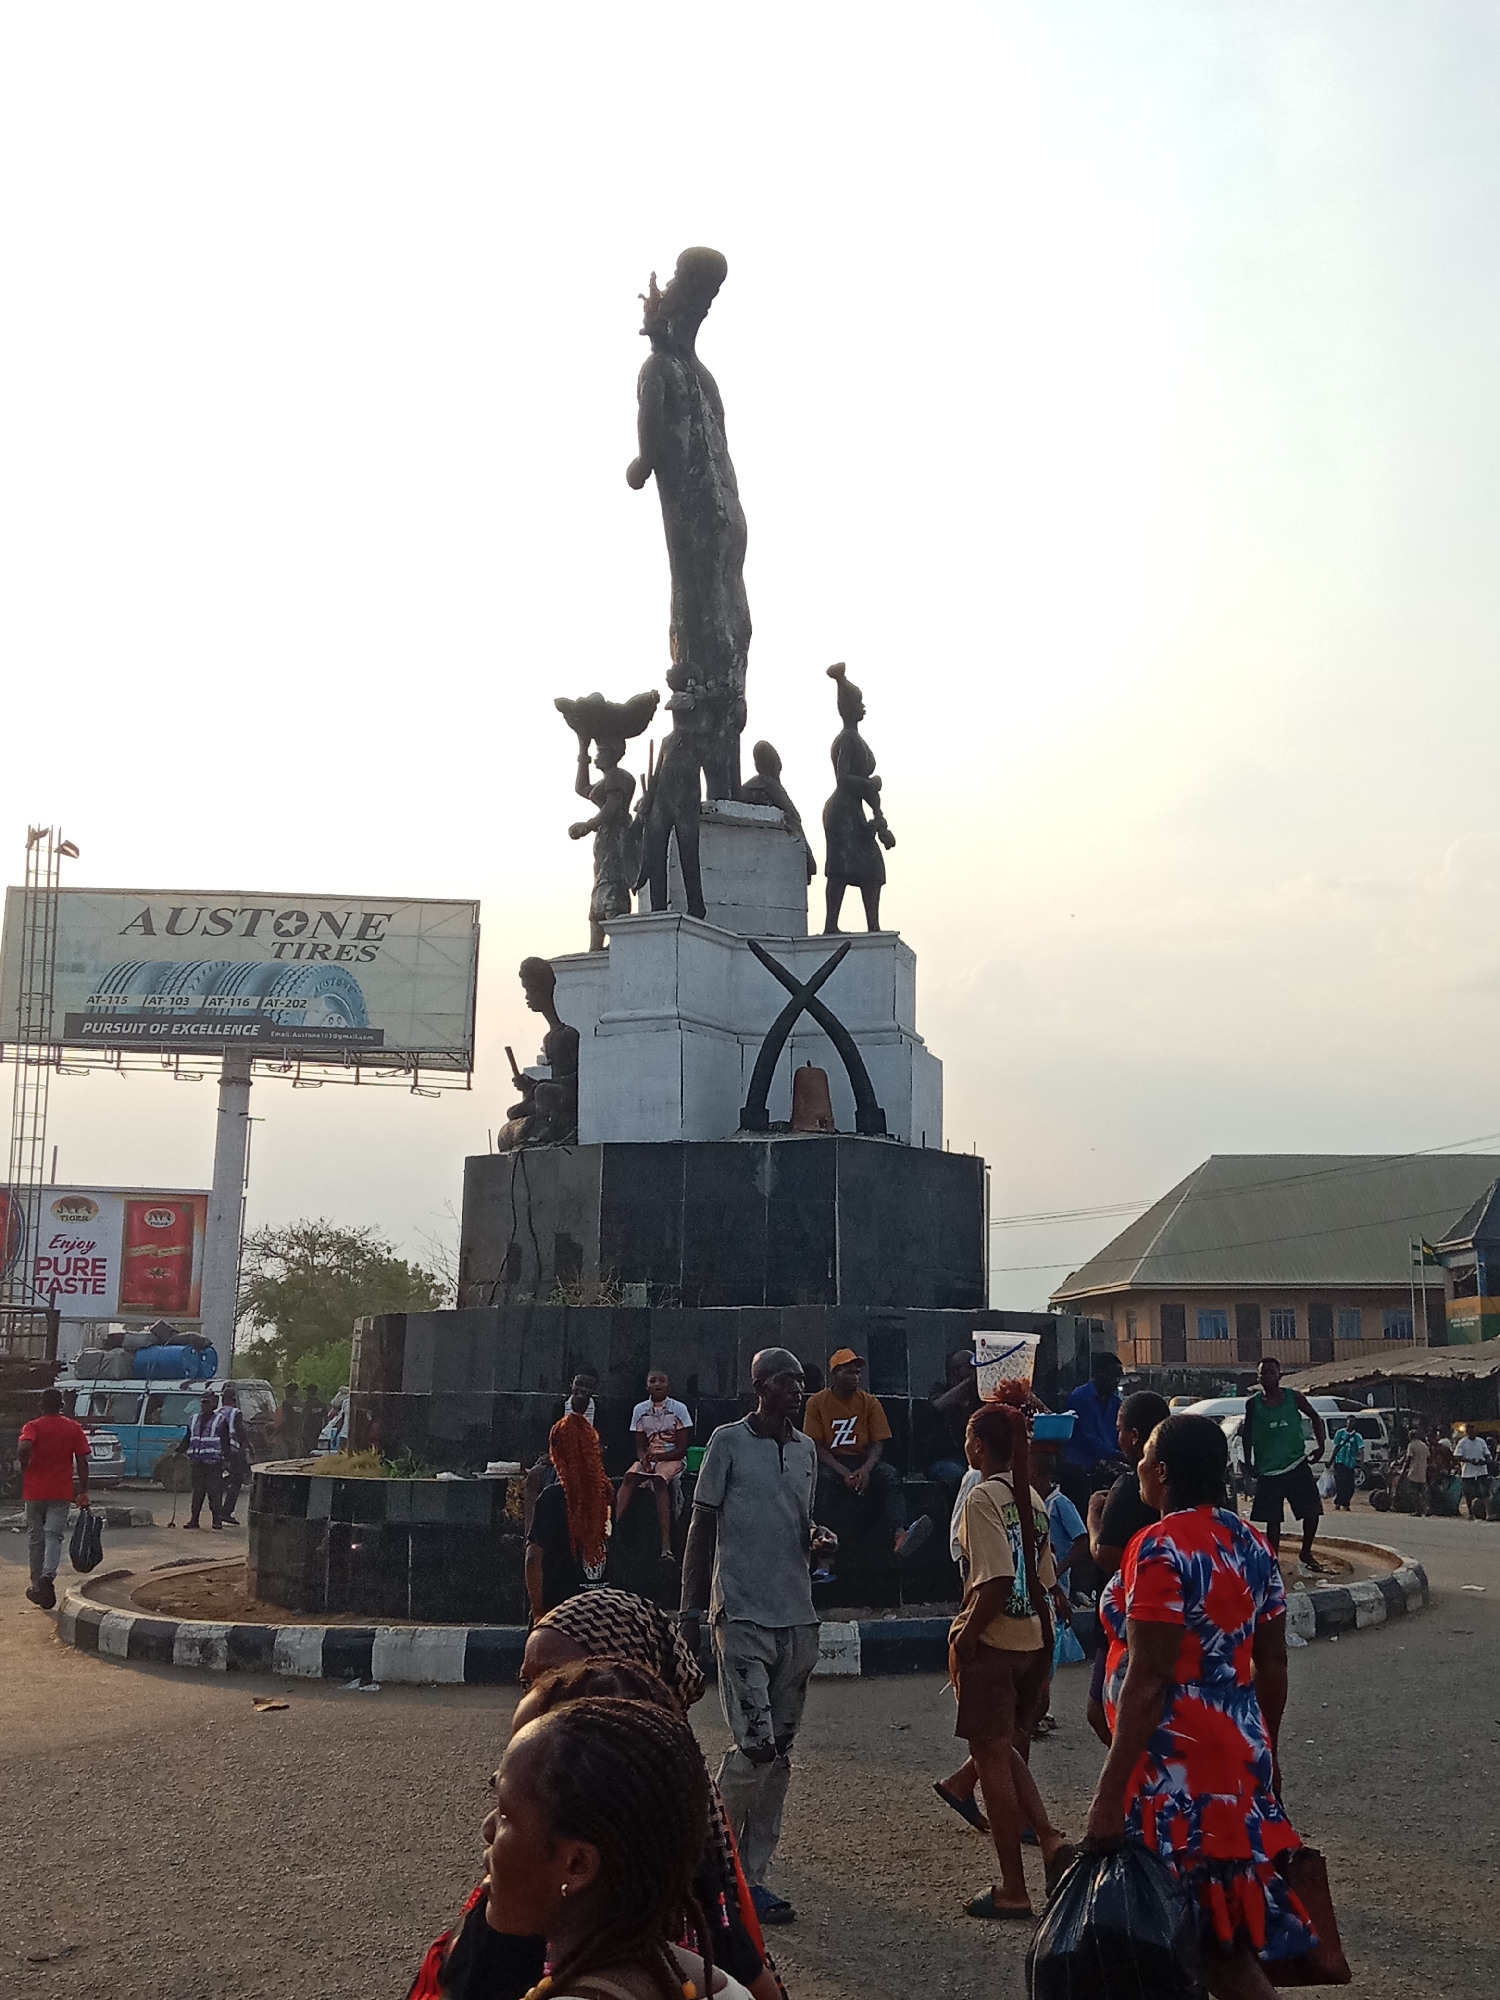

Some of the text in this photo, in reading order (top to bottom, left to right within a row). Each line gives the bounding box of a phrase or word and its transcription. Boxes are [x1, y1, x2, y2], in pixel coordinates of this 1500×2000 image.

[118, 906, 393, 942] AUSTONE
[271, 942, 380, 963] TIRES
[86, 995, 307, 1009] AT-115 AT-103 AT-116 AT-202
[82, 1022, 261, 1036] PURSUIT OF EXCELLENCE
[59, 1214, 89, 1222] TIGER
[48, 1233, 97, 1255] Enjoy
[36, 1256, 107, 1277] PURE
[34, 1276, 106, 1295] TASTE
